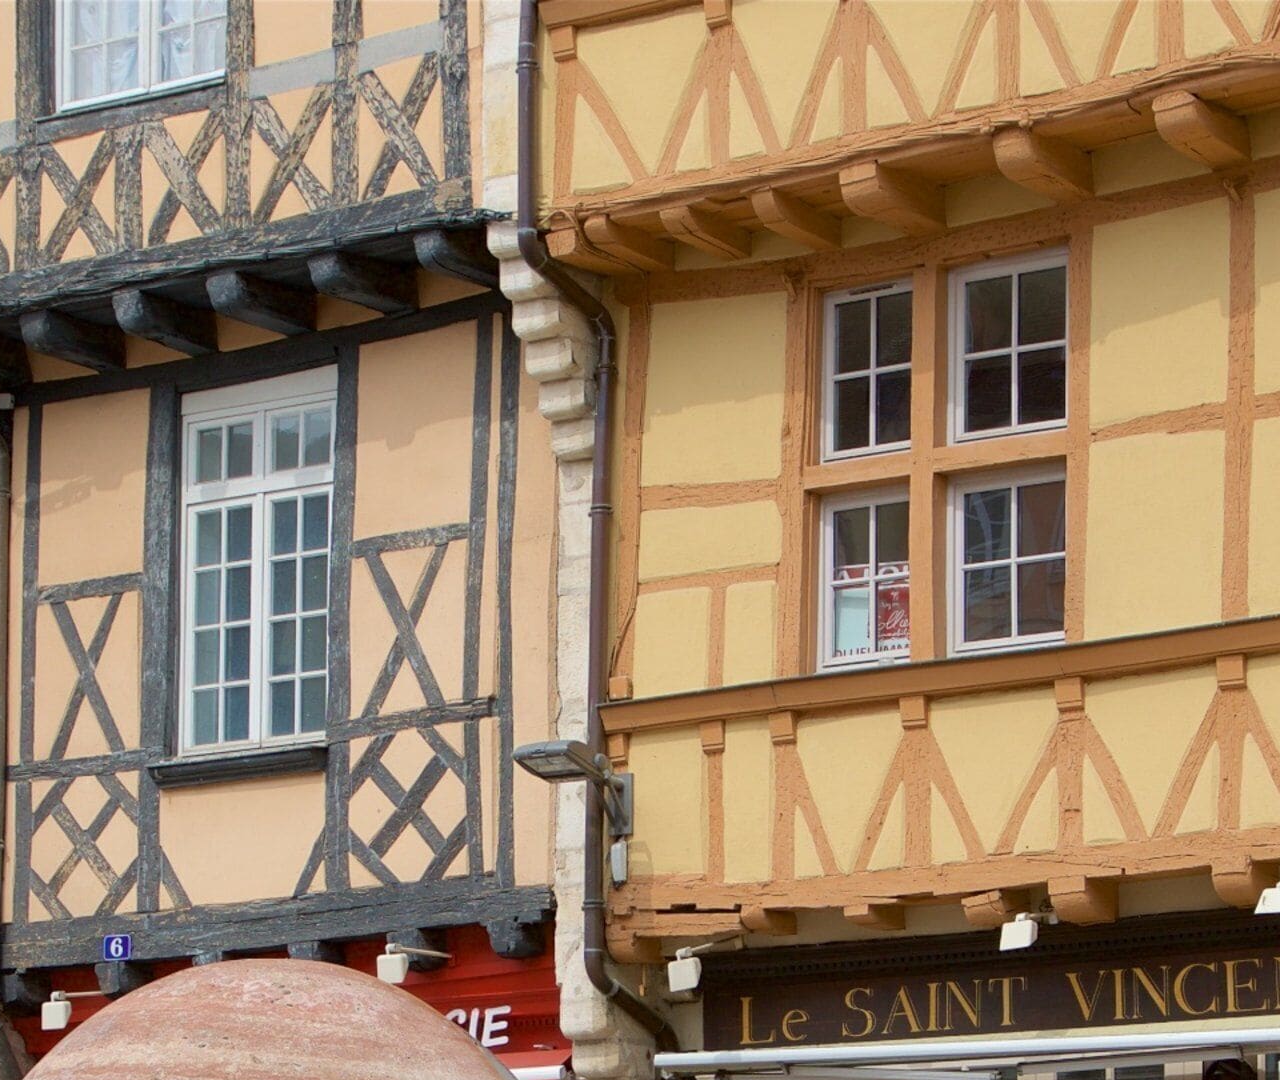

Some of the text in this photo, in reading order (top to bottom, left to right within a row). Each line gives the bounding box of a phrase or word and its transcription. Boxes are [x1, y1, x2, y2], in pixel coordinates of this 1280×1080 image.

[110, 937, 124, 958] 6
[738, 996, 810, 1045] Le
[841, 976, 1029, 1039] SAINT
